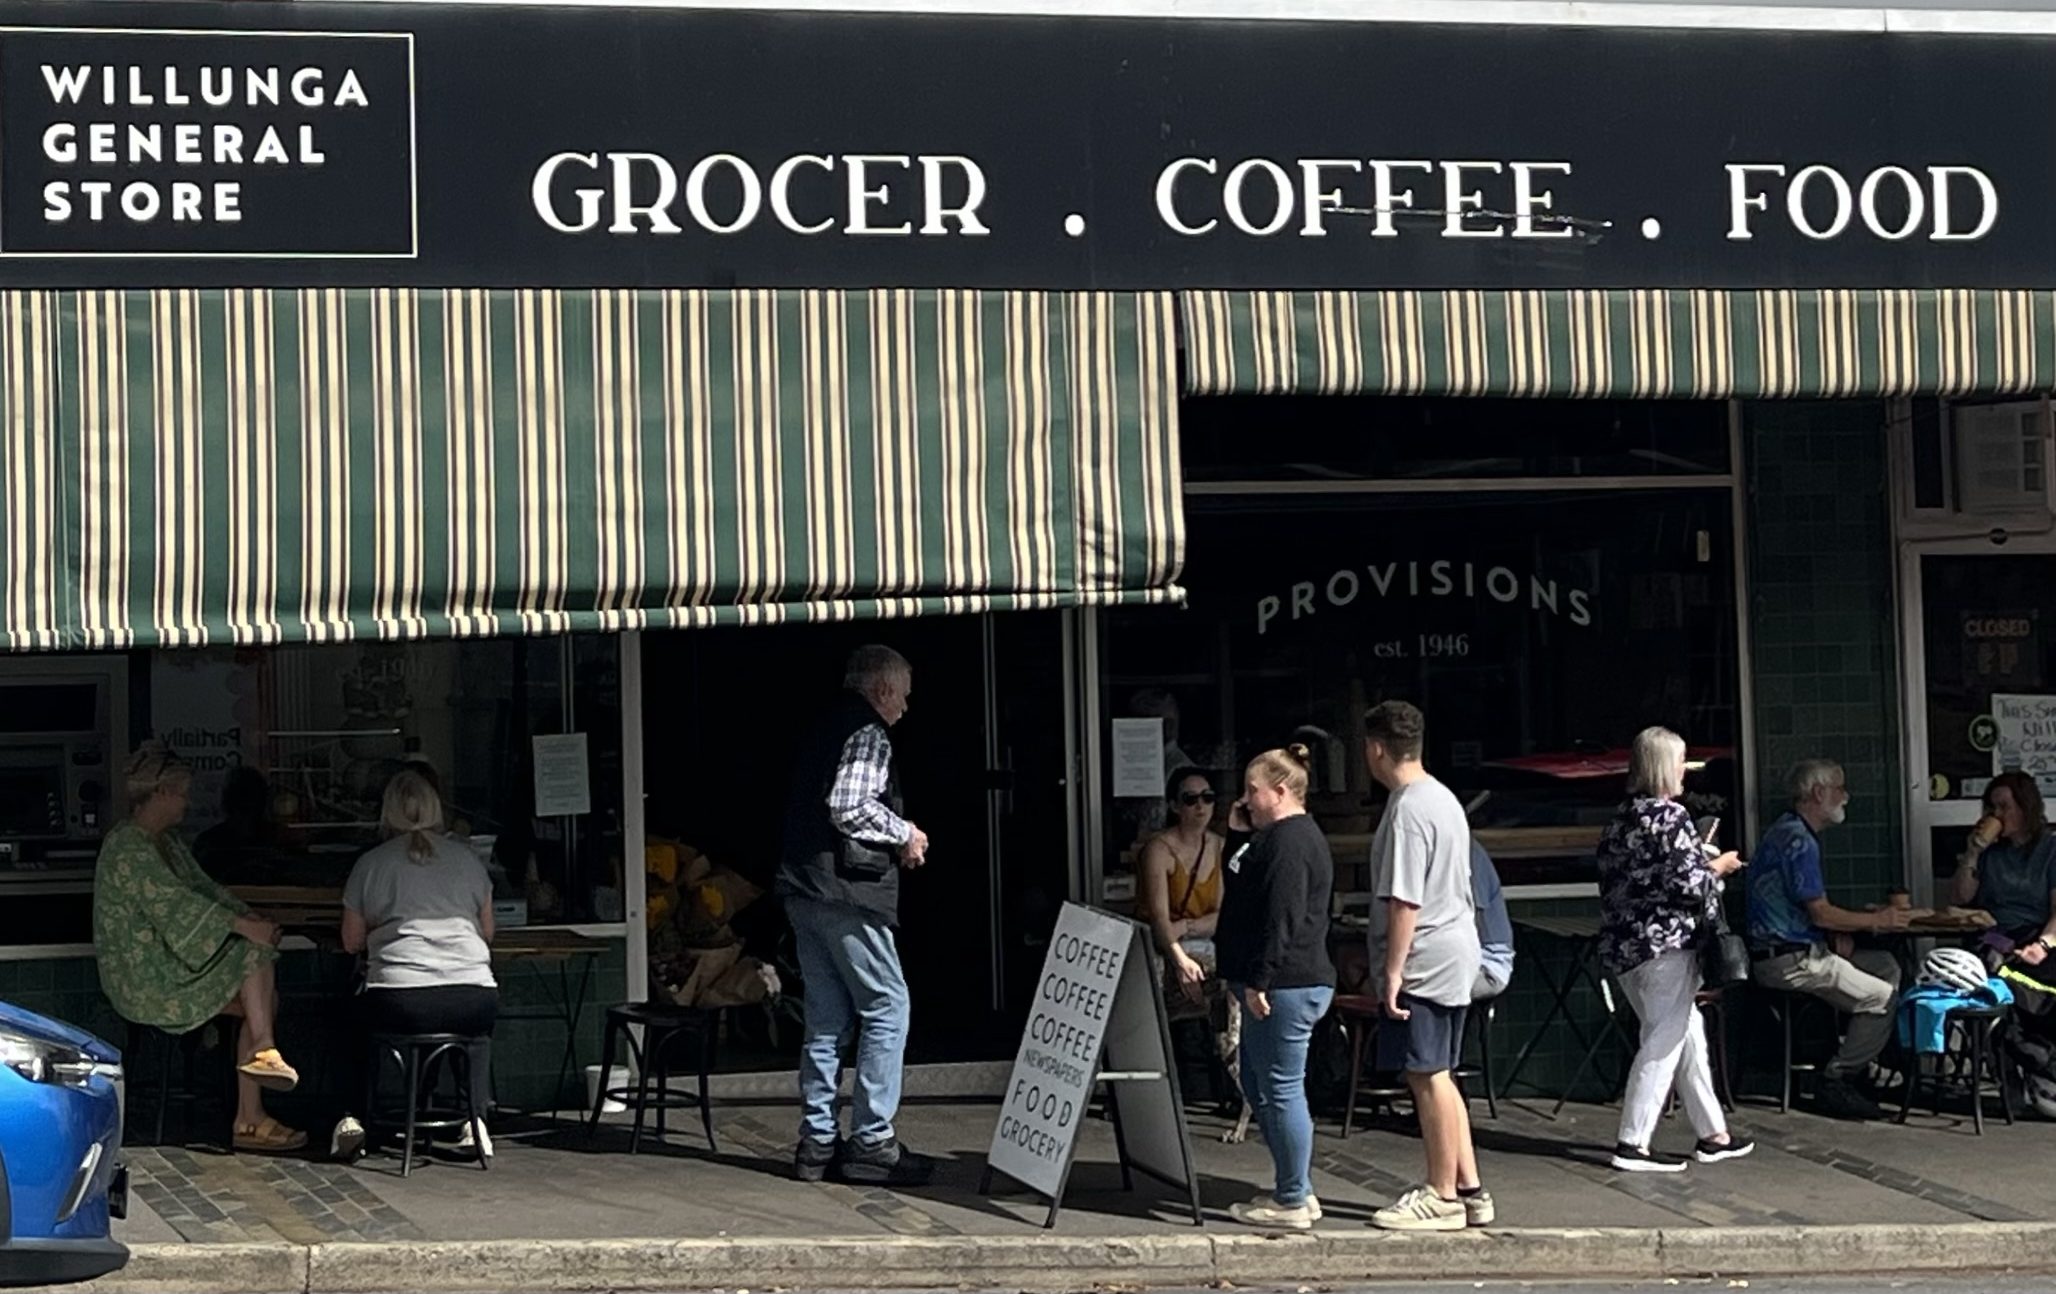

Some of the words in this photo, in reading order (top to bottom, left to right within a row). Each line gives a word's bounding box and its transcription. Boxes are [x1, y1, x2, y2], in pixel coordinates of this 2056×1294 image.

[41, 65, 368, 107] WILLUNGA
[42, 123, 325, 164] GENERAL
[43, 181, 242, 222] STORE
[532, 152, 990, 236] GROCER
[1156, 158, 1574, 239] COFFEE
[1725, 163, 1998, 241] FOOD
[1258, 560, 1591, 634] PROVISIONS
[1374, 637, 1408, 658] est.
[1418, 633, 1470, 658] 1946
[1964, 618, 2031, 638] CLOSED
[1054, 932, 1120, 979] COFFEE
[1042, 972, 1108, 1021] COFFEE
[1031, 1012, 1096, 1062] COFFEE
[1023, 1050, 1084, 1089] NEWSPAPERS
[1012, 1078, 1073, 1128] FOOD
[1001, 1115, 1065, 1163] GROCERY
